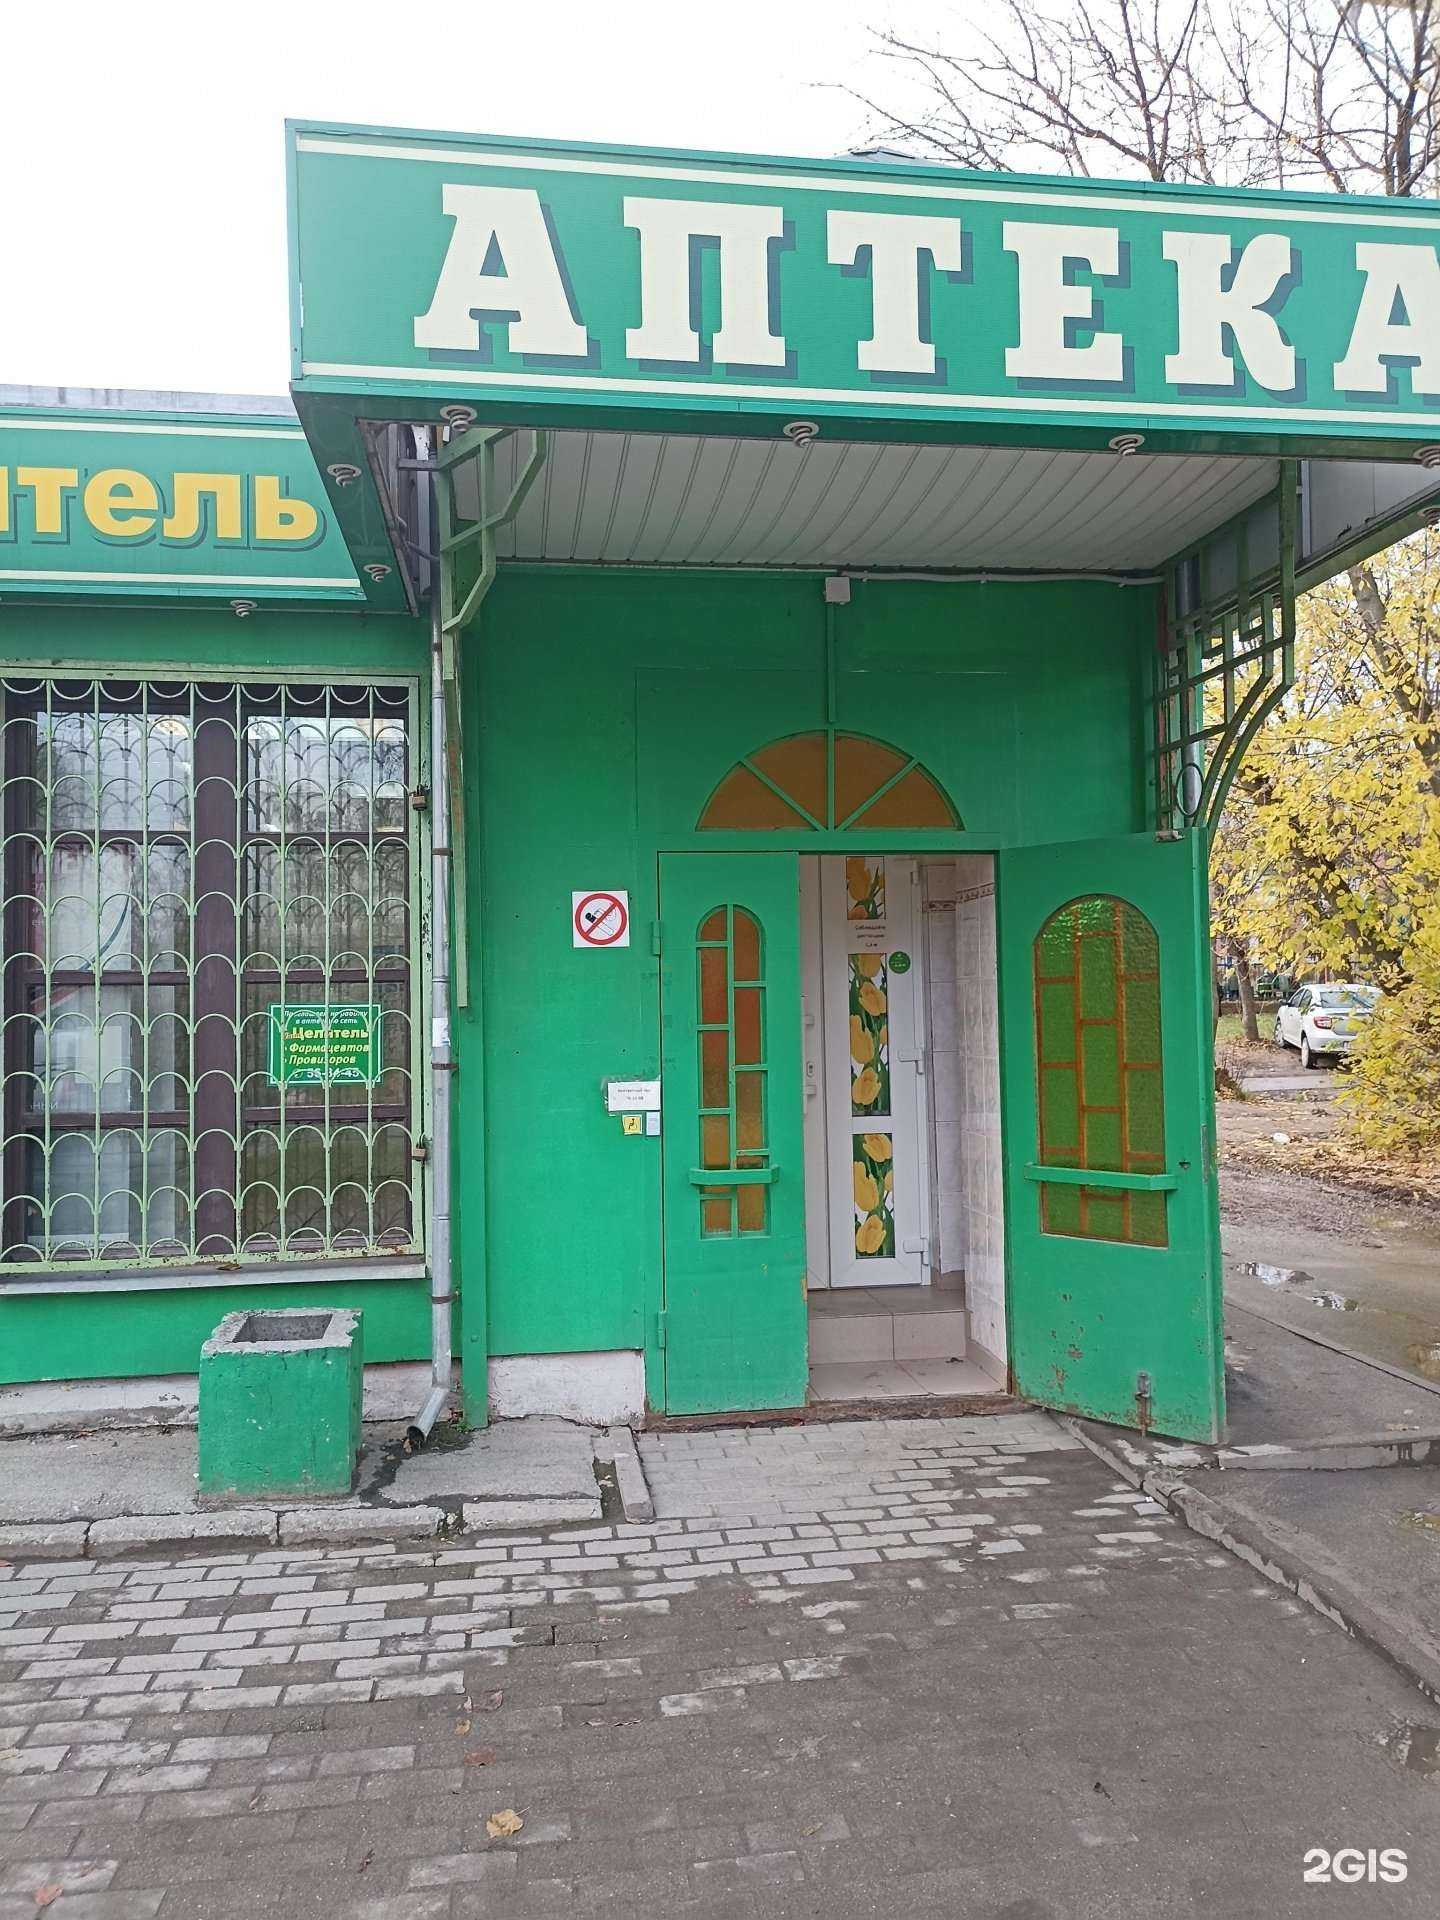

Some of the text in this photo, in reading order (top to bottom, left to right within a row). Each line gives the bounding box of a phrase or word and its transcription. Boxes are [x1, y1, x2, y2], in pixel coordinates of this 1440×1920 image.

[413, 183, 1440, 396] АПТЕКА
[0, 466, 318, 541] тель
[289, 1055, 356, 1066] Провиоров
